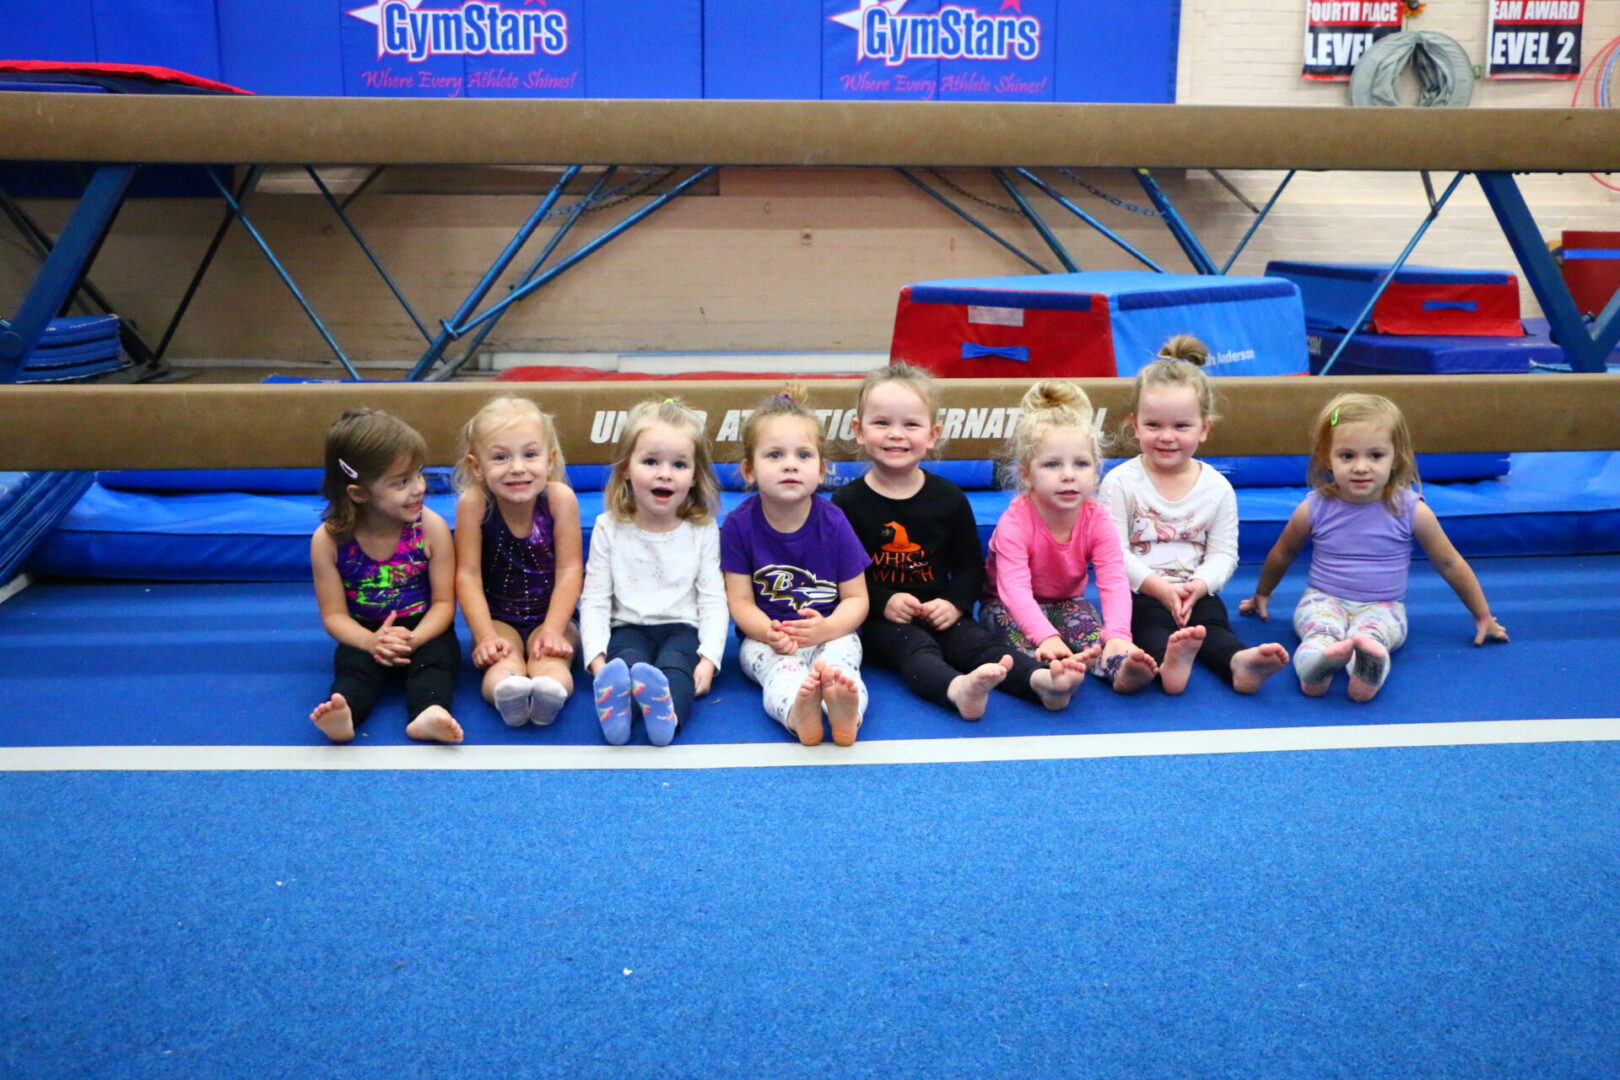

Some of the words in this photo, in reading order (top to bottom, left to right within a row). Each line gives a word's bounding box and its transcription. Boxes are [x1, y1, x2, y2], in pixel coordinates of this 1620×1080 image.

[1308, 2, 1360, 21] OURTH
[1362, 2, 1398, 21] PLACE
[1492, 1, 1522, 20] EAM
[1523, 1, 1580, 20] AWARD
[383, 2, 566, 61] GymStars
[864, 7, 1039, 64] GymStars
[1491, 31, 1550, 65] EVEL
[1555, 31, 1575, 65] 2
[361, 68, 413, 89] Where
[418, 70, 463, 98] Every
[467, 68, 519, 89] Athlete
[522, 68, 578, 89] Shines!
[840, 72, 891, 92] Where
[895, 74, 937, 101] Every
[939, 72, 990, 93] Athlete
[994, 73, 1049, 94] Shines!
